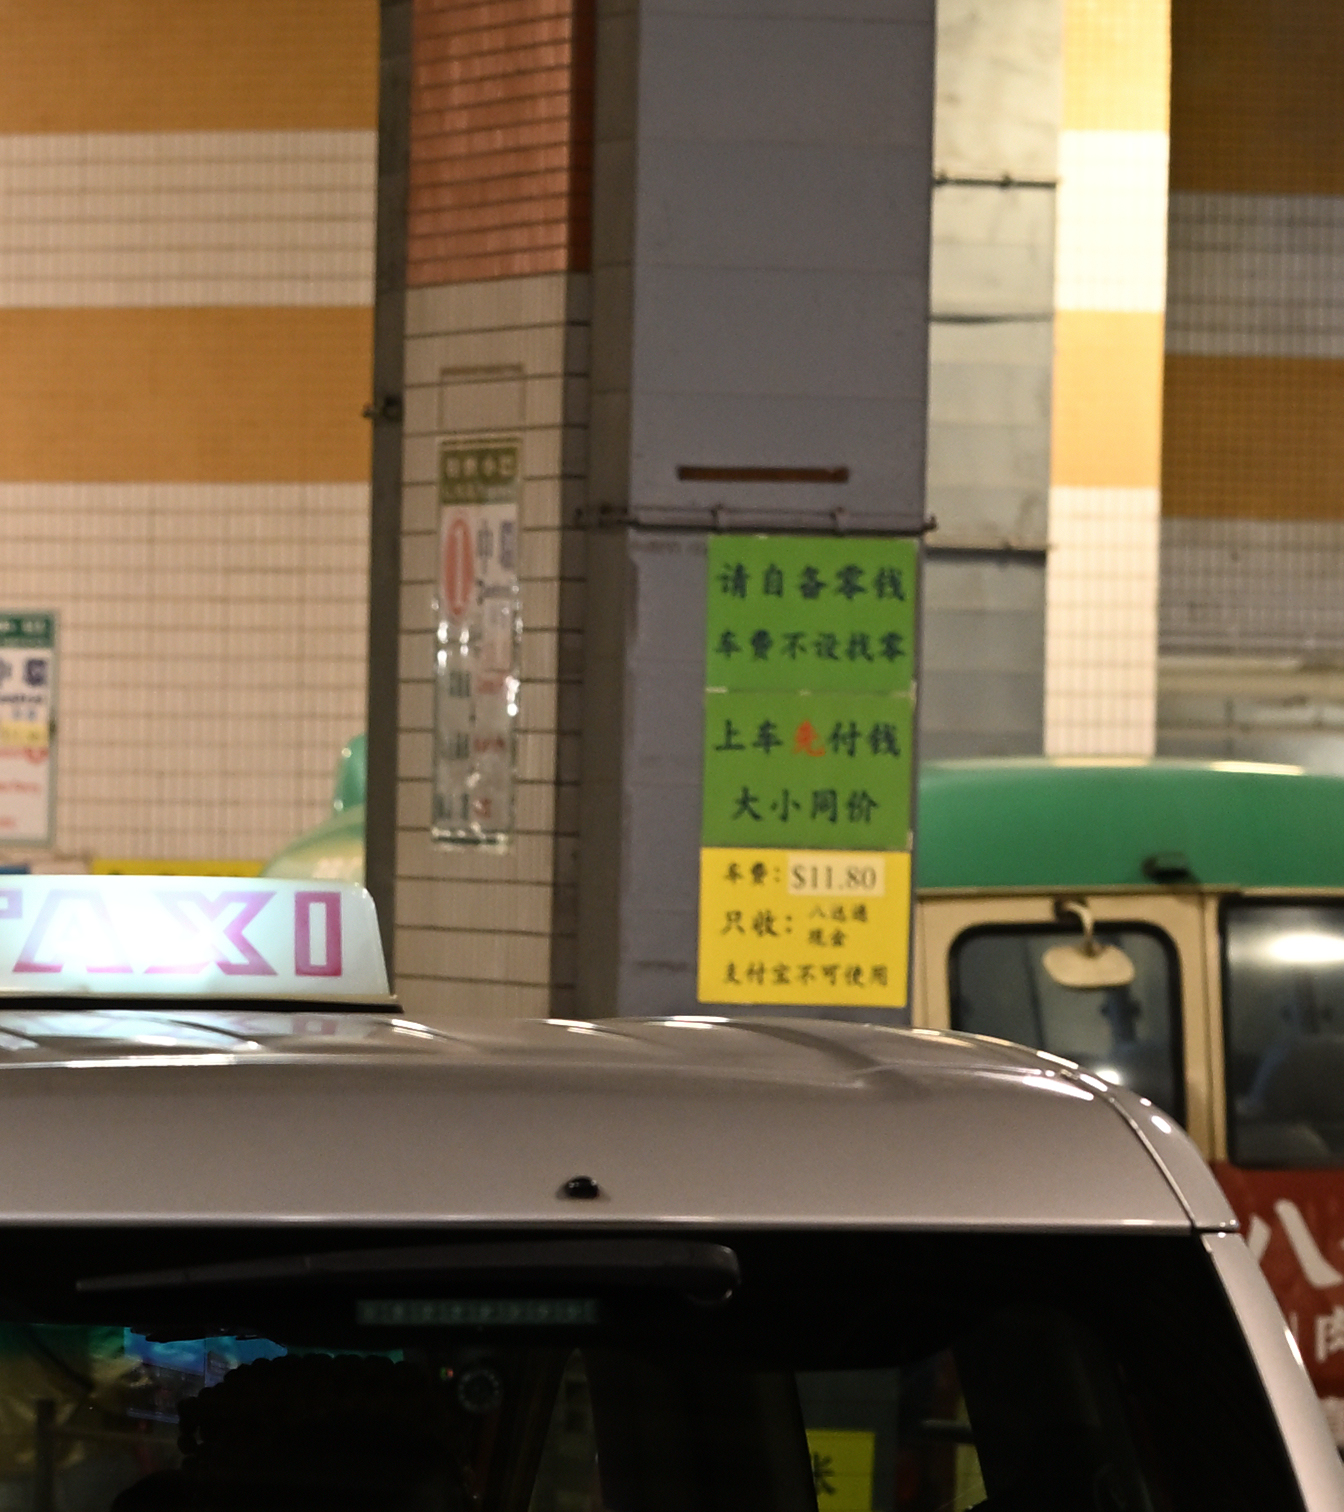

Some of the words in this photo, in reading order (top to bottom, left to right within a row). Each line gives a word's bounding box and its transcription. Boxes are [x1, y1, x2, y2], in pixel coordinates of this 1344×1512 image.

[717, 562, 906, 601] 请自备零钱
[716, 629, 906, 662] 车费不设找零
[732, 786, 879, 824] 大小同价
[791, 864, 878, 890] $11.80
